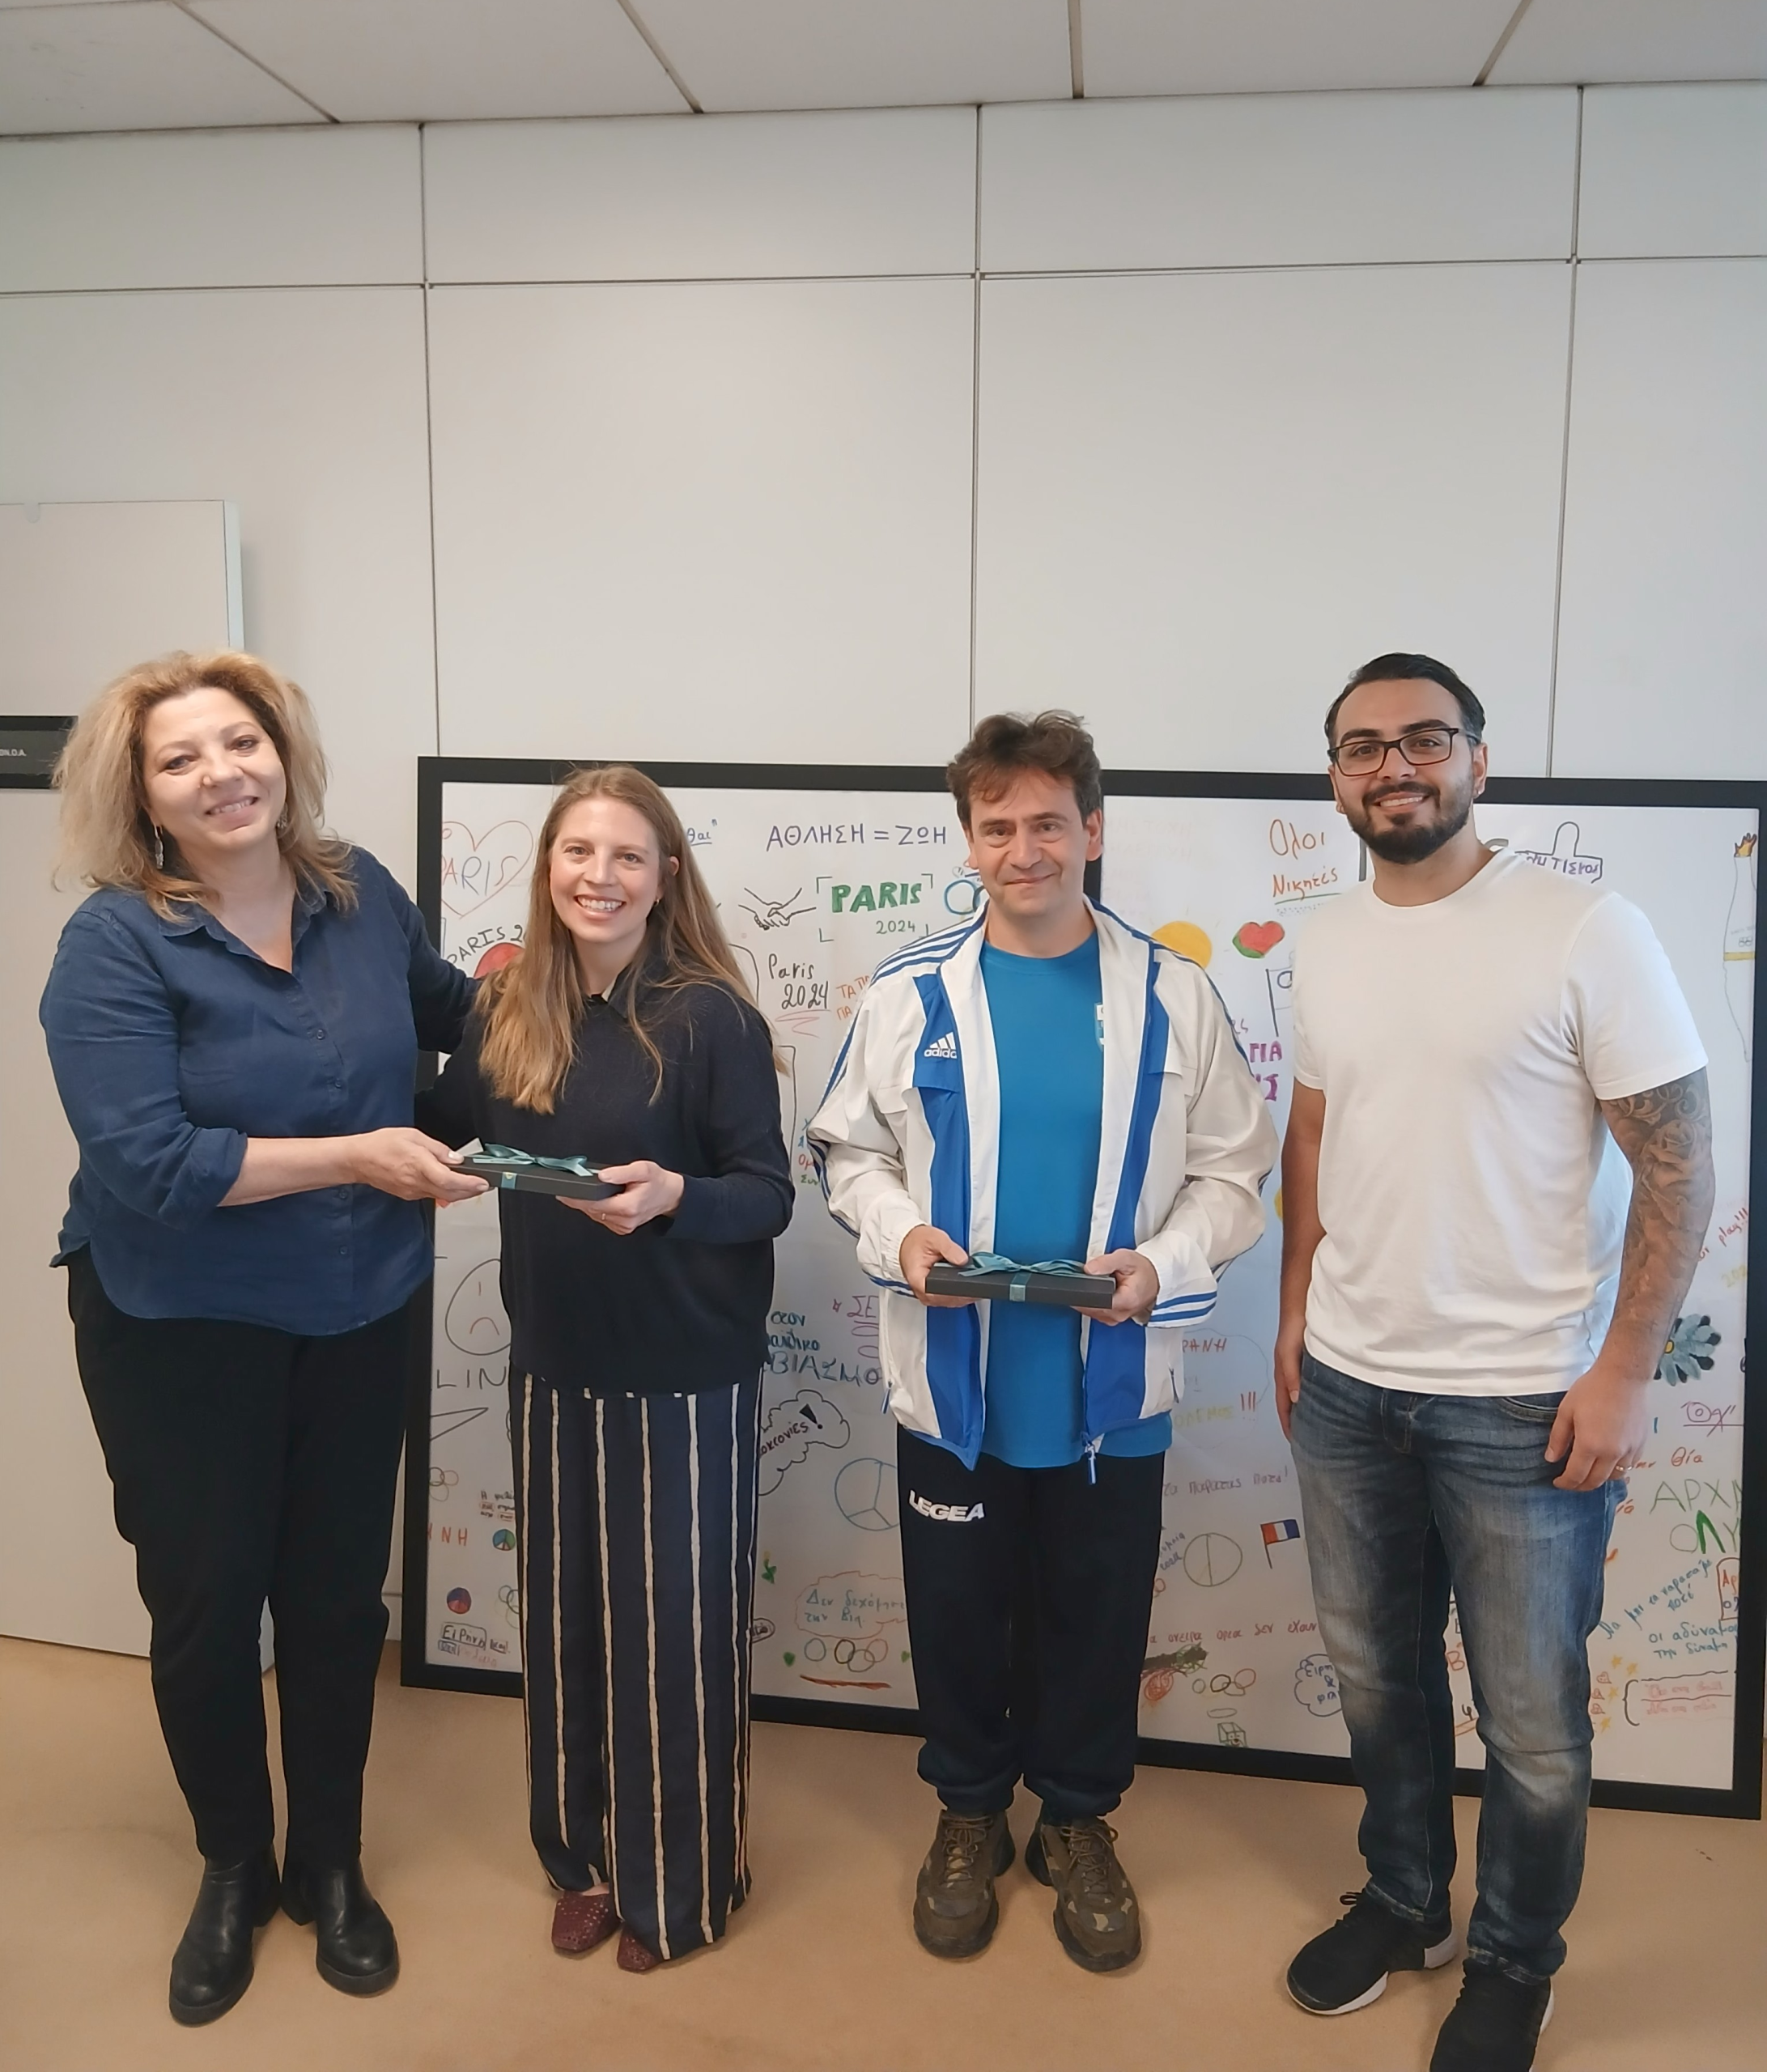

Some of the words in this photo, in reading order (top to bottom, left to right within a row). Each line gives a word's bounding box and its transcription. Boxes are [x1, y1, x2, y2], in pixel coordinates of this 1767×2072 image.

[766, 823, 864, 851] ΑΘΛΗΣΗ
[830, 882, 922, 913] PARIS
[876, 920, 916, 935] 2024
[768, 953, 814, 980] Paris
[781, 981, 829, 1010] 2024
[909, 1489, 985, 1522] LEGEA
